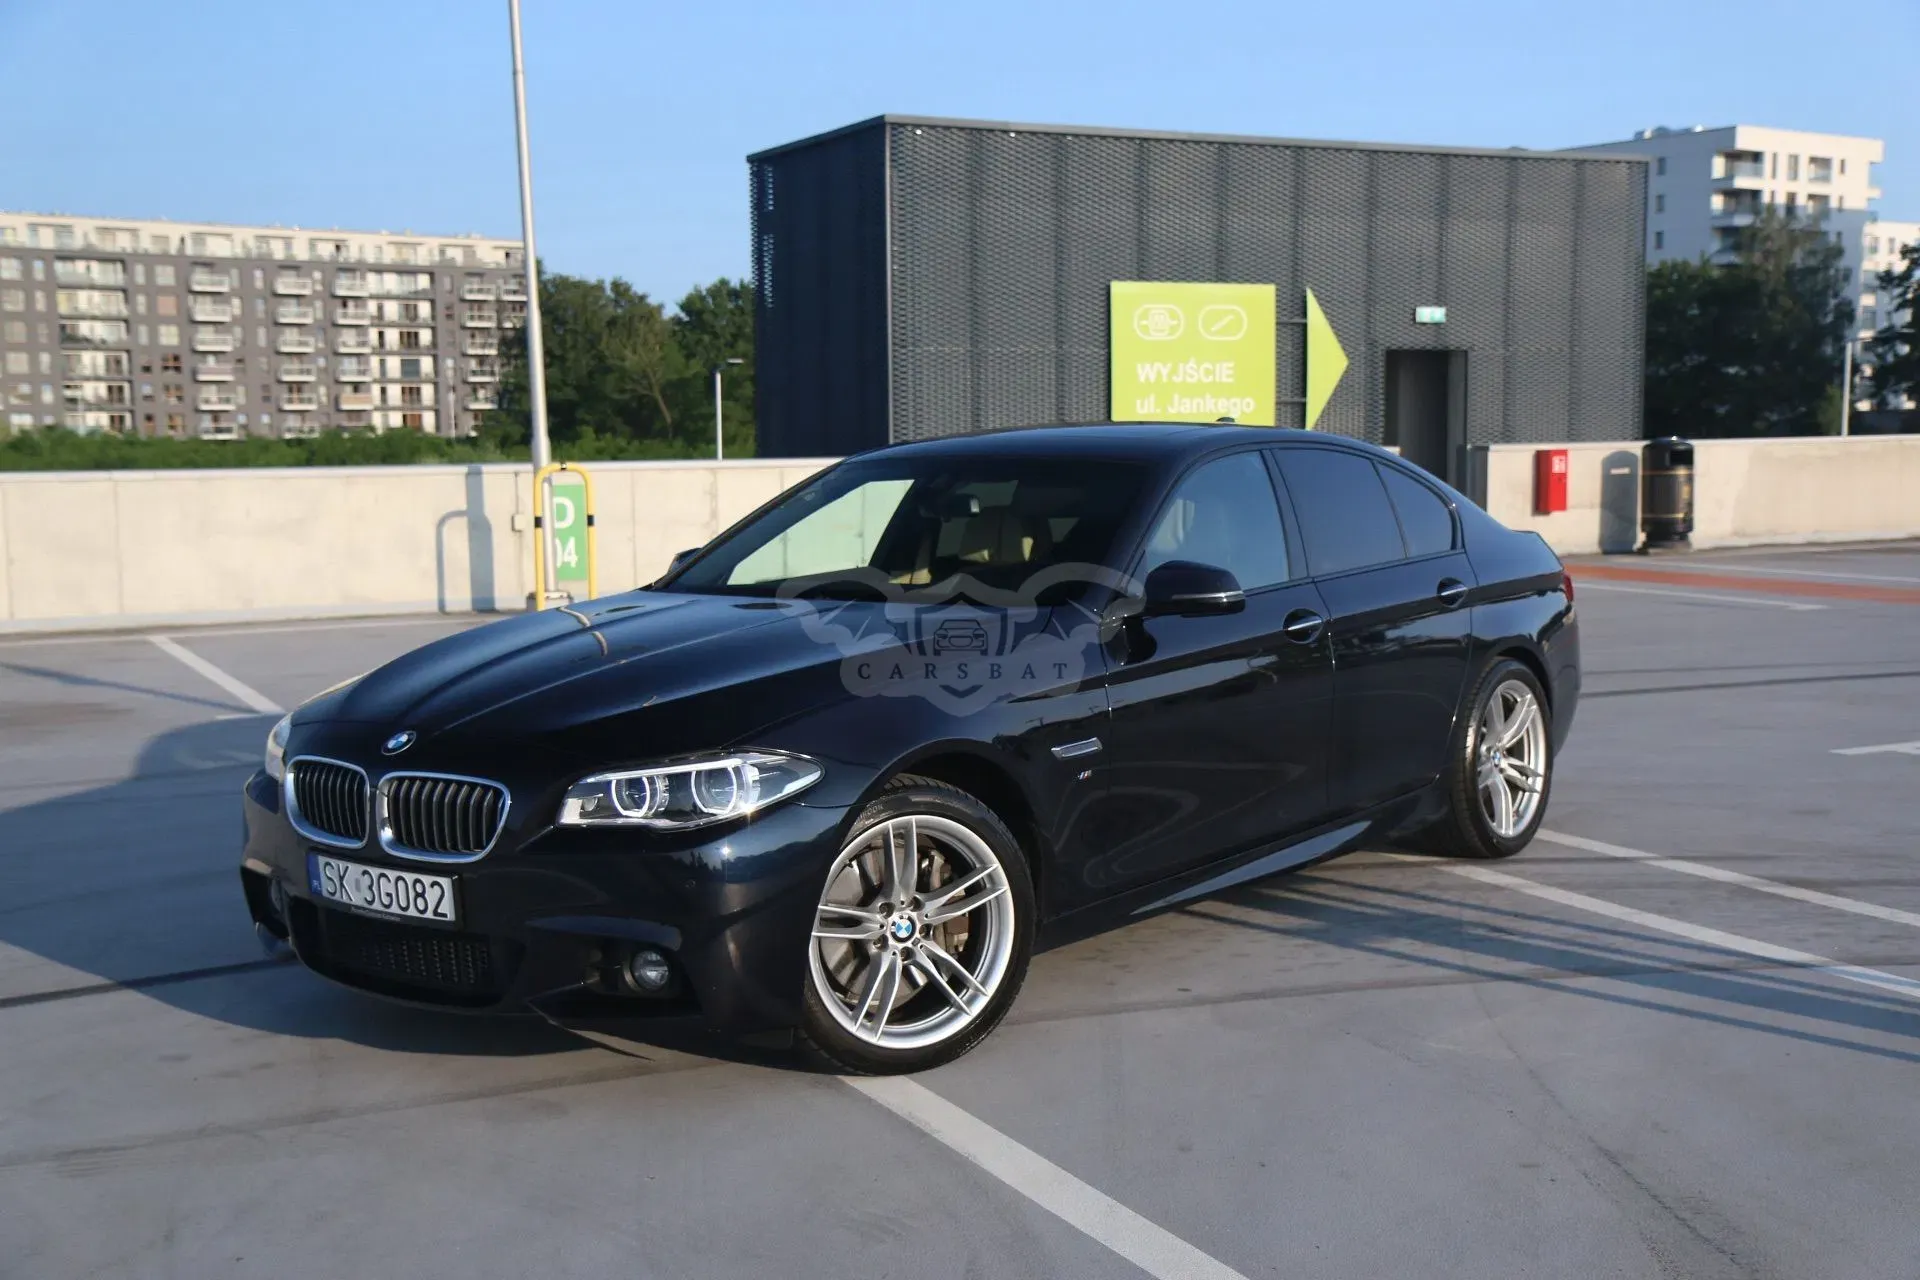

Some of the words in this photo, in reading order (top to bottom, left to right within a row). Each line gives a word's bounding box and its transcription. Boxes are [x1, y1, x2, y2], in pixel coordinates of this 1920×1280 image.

[1136, 357, 1235, 383] WYJŚCIE
[1135, 395, 1160, 414] ul.
[1167, 393, 1255, 418] Jankego
[553, 496, 575, 529] D
[323, 861, 353, 901] SK
[361, 869, 449, 918] 3G082
